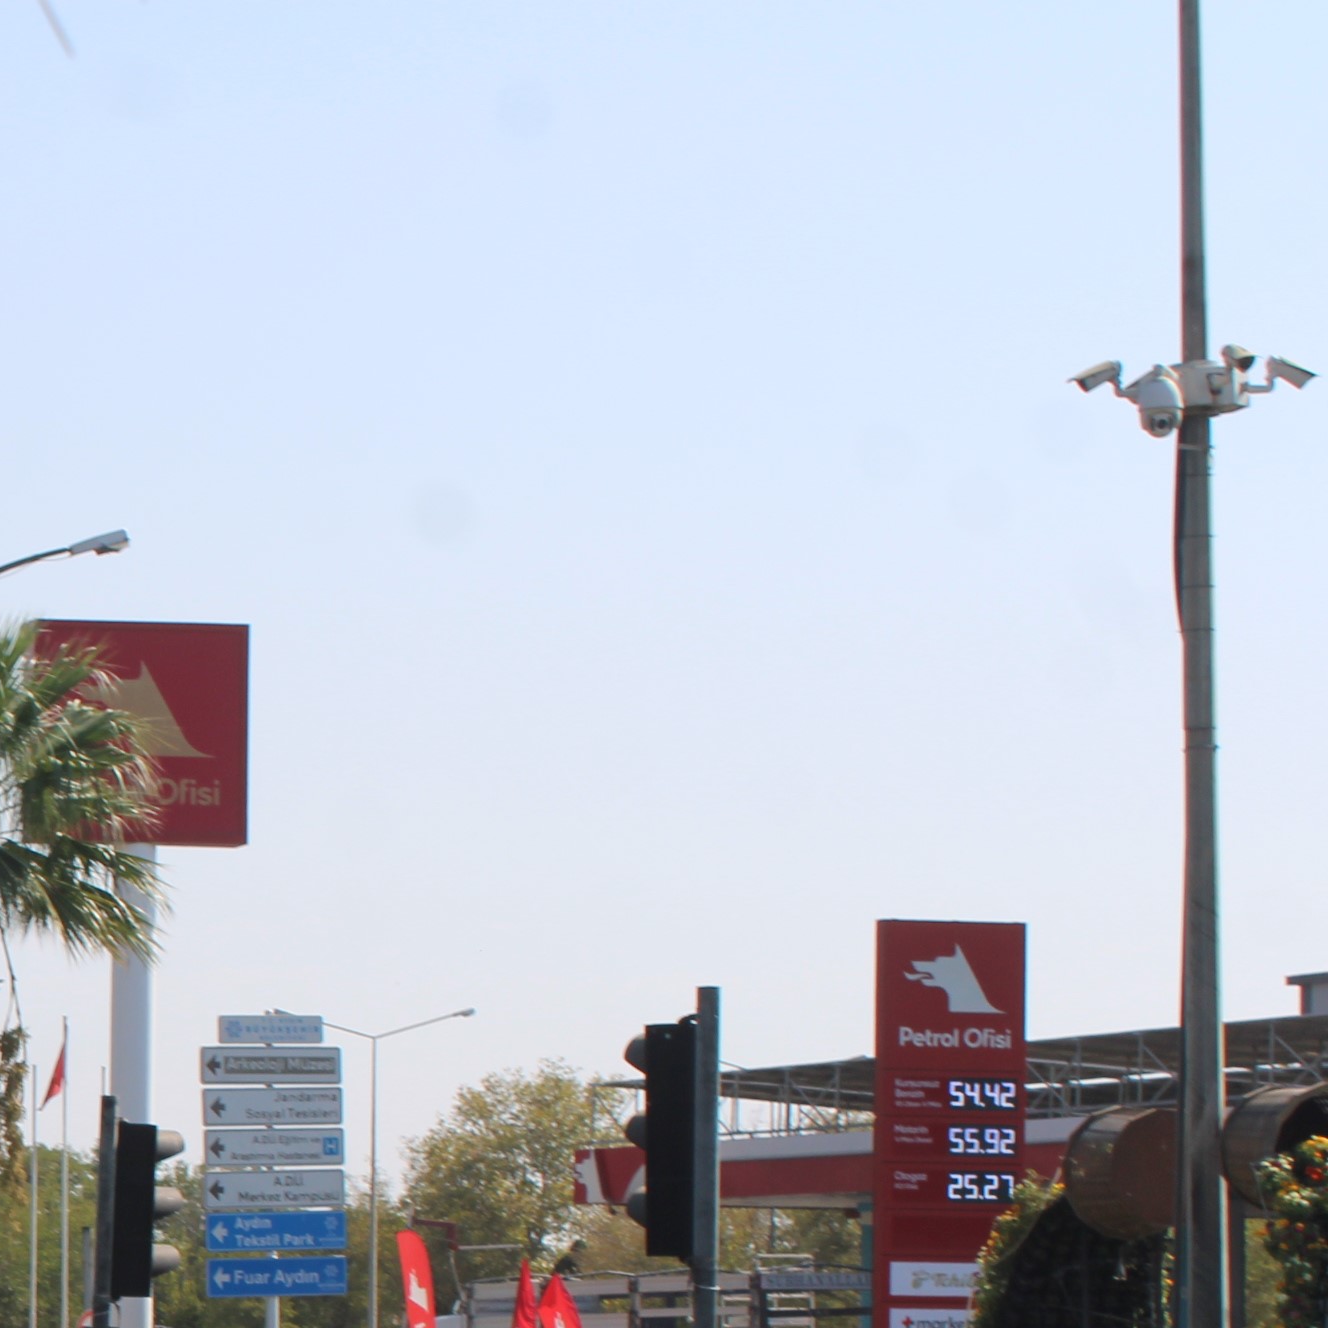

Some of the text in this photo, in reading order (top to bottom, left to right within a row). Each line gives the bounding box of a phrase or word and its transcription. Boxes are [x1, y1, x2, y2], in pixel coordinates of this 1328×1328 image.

[155, 778, 221, 806] Ofisi
[899, 1026, 1013, 1049] Petrol Ofisi
[274, 1092, 338, 1103] Jandarma
[948, 1081, 1016, 1108] 54.42
[245, 1107, 284, 1121] Sosyal
[948, 1127, 1016, 1154] 55.92
[947, 1173, 1014, 1200] 25.27
[233, 1216, 272, 1232] Aydın
[234, 1233, 281, 1248] Tekstil
[282, 1233, 315, 1246] Park
[233, 1270, 271, 1285] Fuar
[273, 1269, 320, 1287] Aydın
